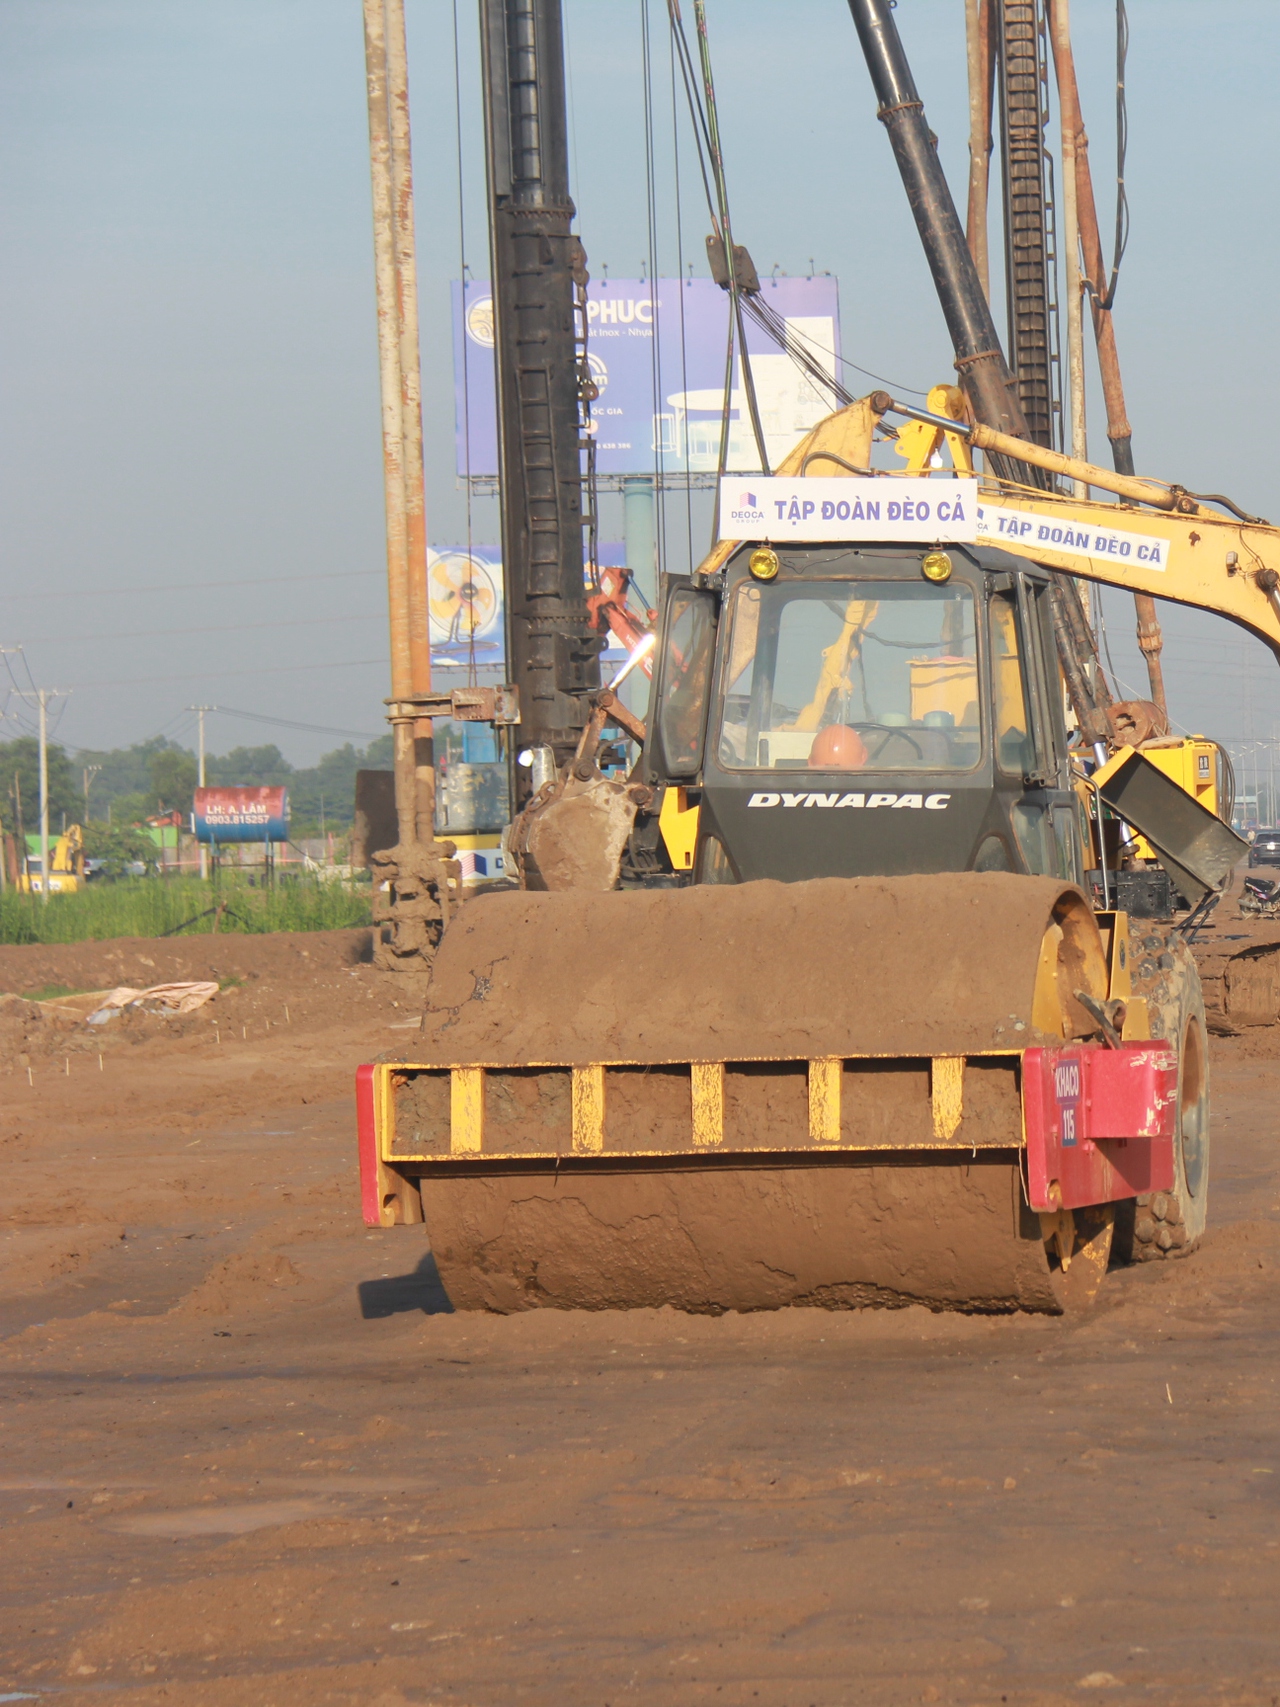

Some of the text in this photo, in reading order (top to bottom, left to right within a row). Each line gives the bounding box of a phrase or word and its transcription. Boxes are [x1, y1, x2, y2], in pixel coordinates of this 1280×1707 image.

[599, 328, 620, 337] Inox
[606, 408, 623, 416] GIA
[731, 510, 765, 519] DEOCA
[774, 493, 966, 525] TẬP ĐOÀN ĐÈO CẢ
[997, 516, 1032, 538] TẬP
[1037, 525, 1090, 549] ĐOÀN
[1095, 534, 1131, 557] ĐÈO
[1137, 541, 1162, 563] CẢ
[747, 792, 952, 810] DYNAPAC
[206, 804, 226, 815] LH:
[205, 815, 270, 825] 0903.815257
[1056, 1065, 1079, 1098] KHACO
[1063, 1109, 1075, 1140] 115
